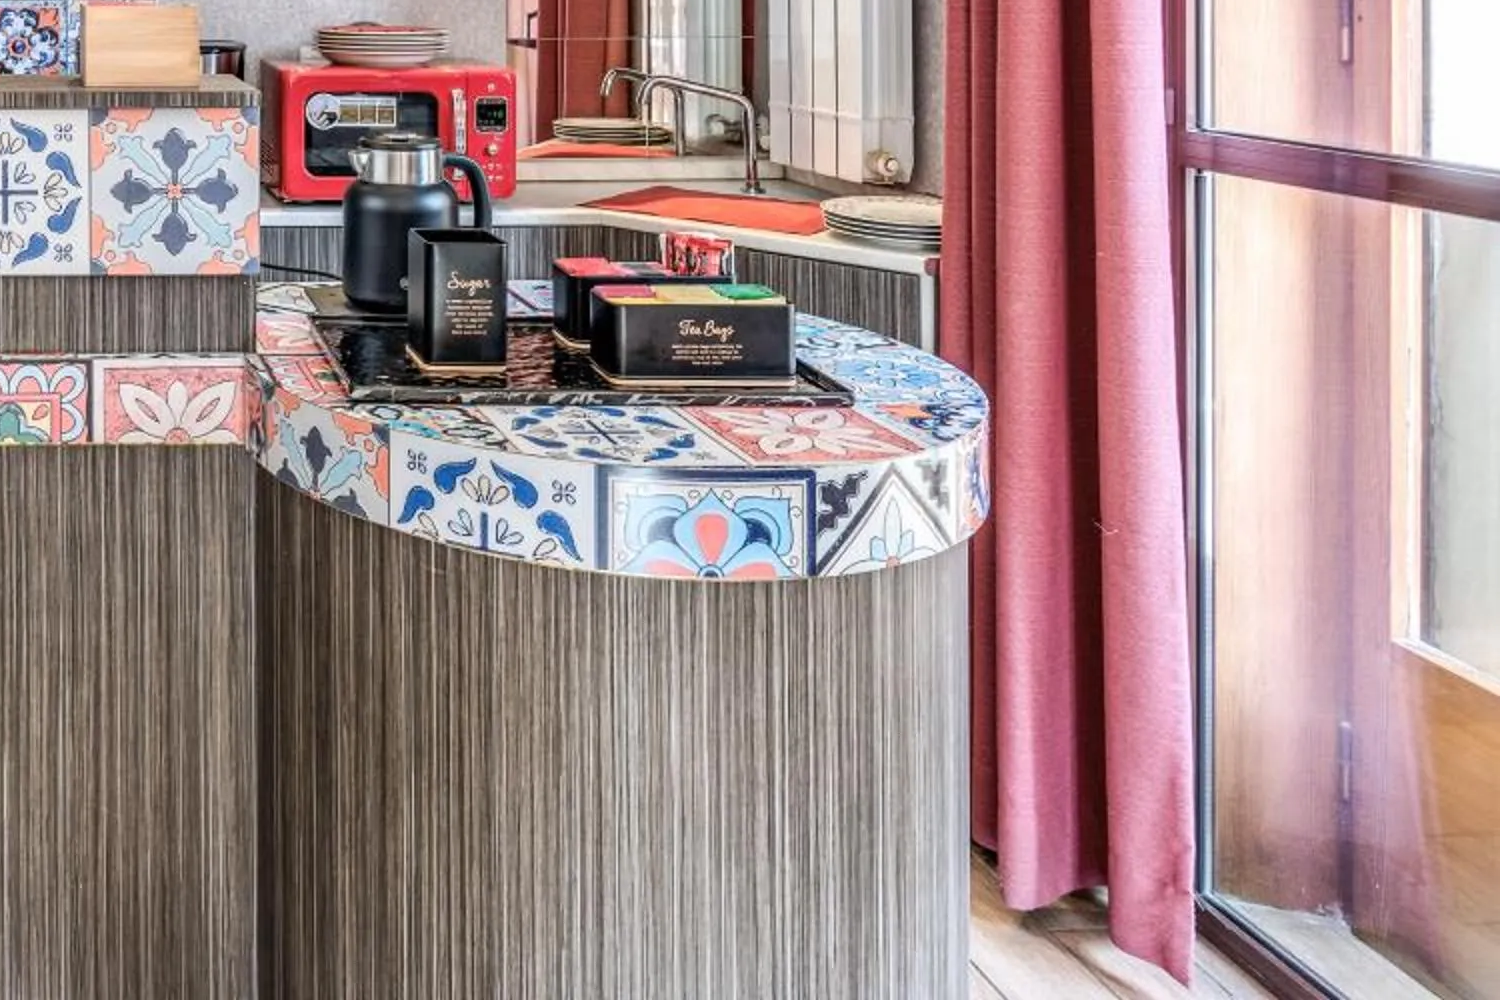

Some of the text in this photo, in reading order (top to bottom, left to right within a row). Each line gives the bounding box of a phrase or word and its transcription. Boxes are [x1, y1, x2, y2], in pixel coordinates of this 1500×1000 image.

[446, 271, 492, 297] Sugar
[678, 319, 736, 343] Tea Bags
